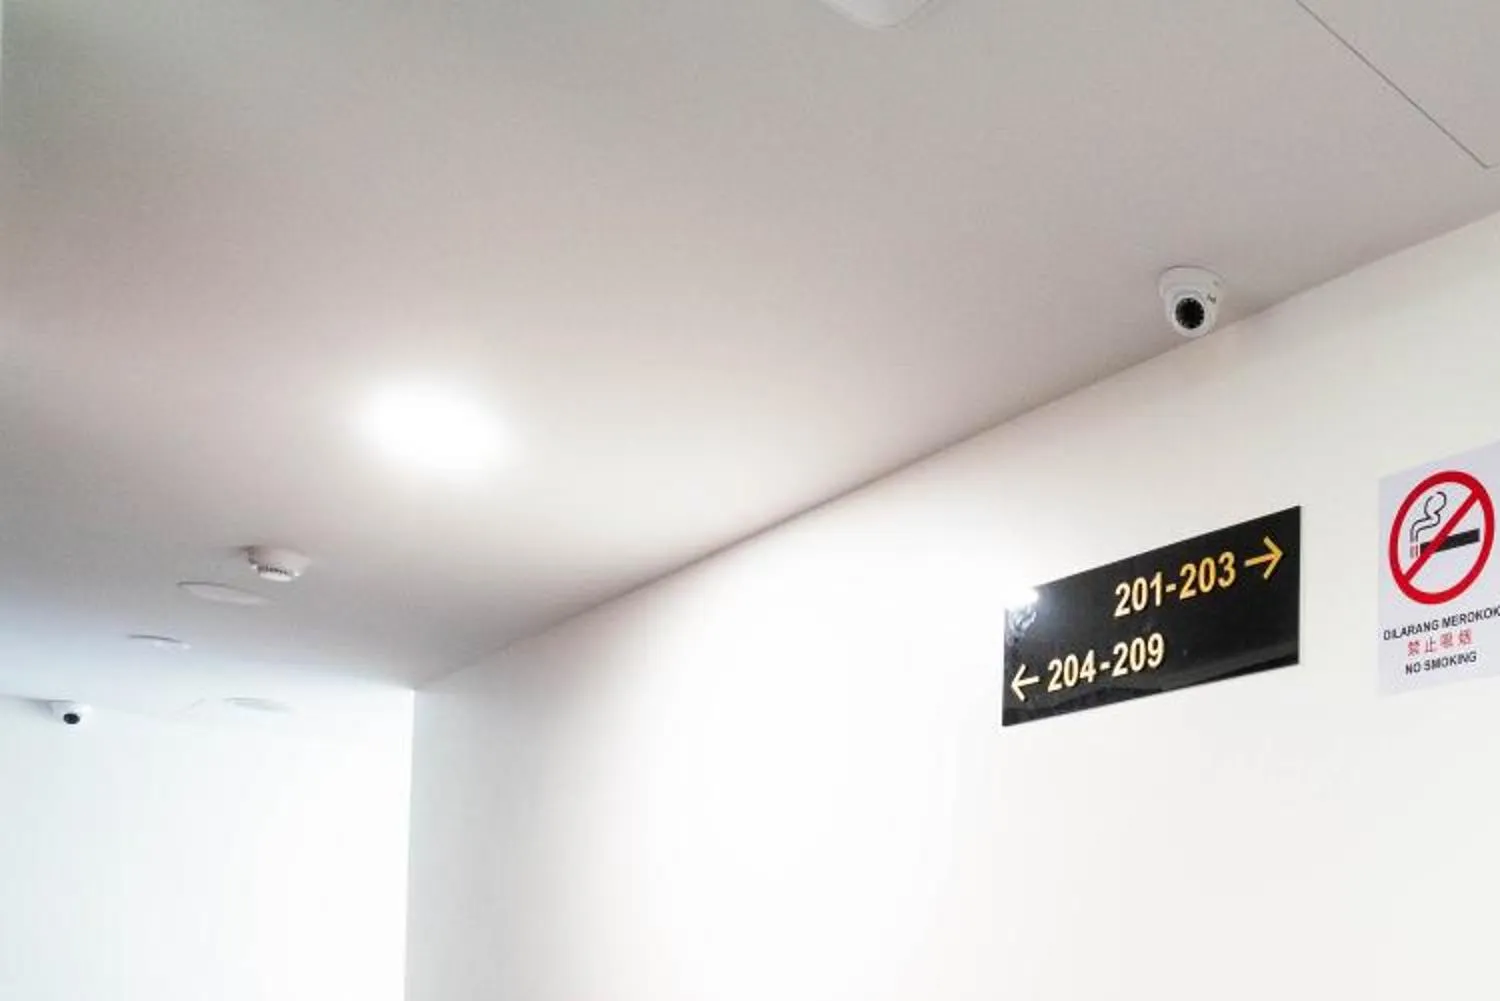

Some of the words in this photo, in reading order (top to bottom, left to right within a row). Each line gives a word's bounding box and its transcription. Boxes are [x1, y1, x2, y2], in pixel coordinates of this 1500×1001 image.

[1113, 550, 1237, 618] 201-203
[1383, 619, 1440, 641] DILARANG
[1441, 605, 1500, 629] MEROKOK
[1046, 632, 1165, 693] 204-209
[1405, 661, 1421, 675] NO
[1423, 651, 1477, 672] SMOKING
